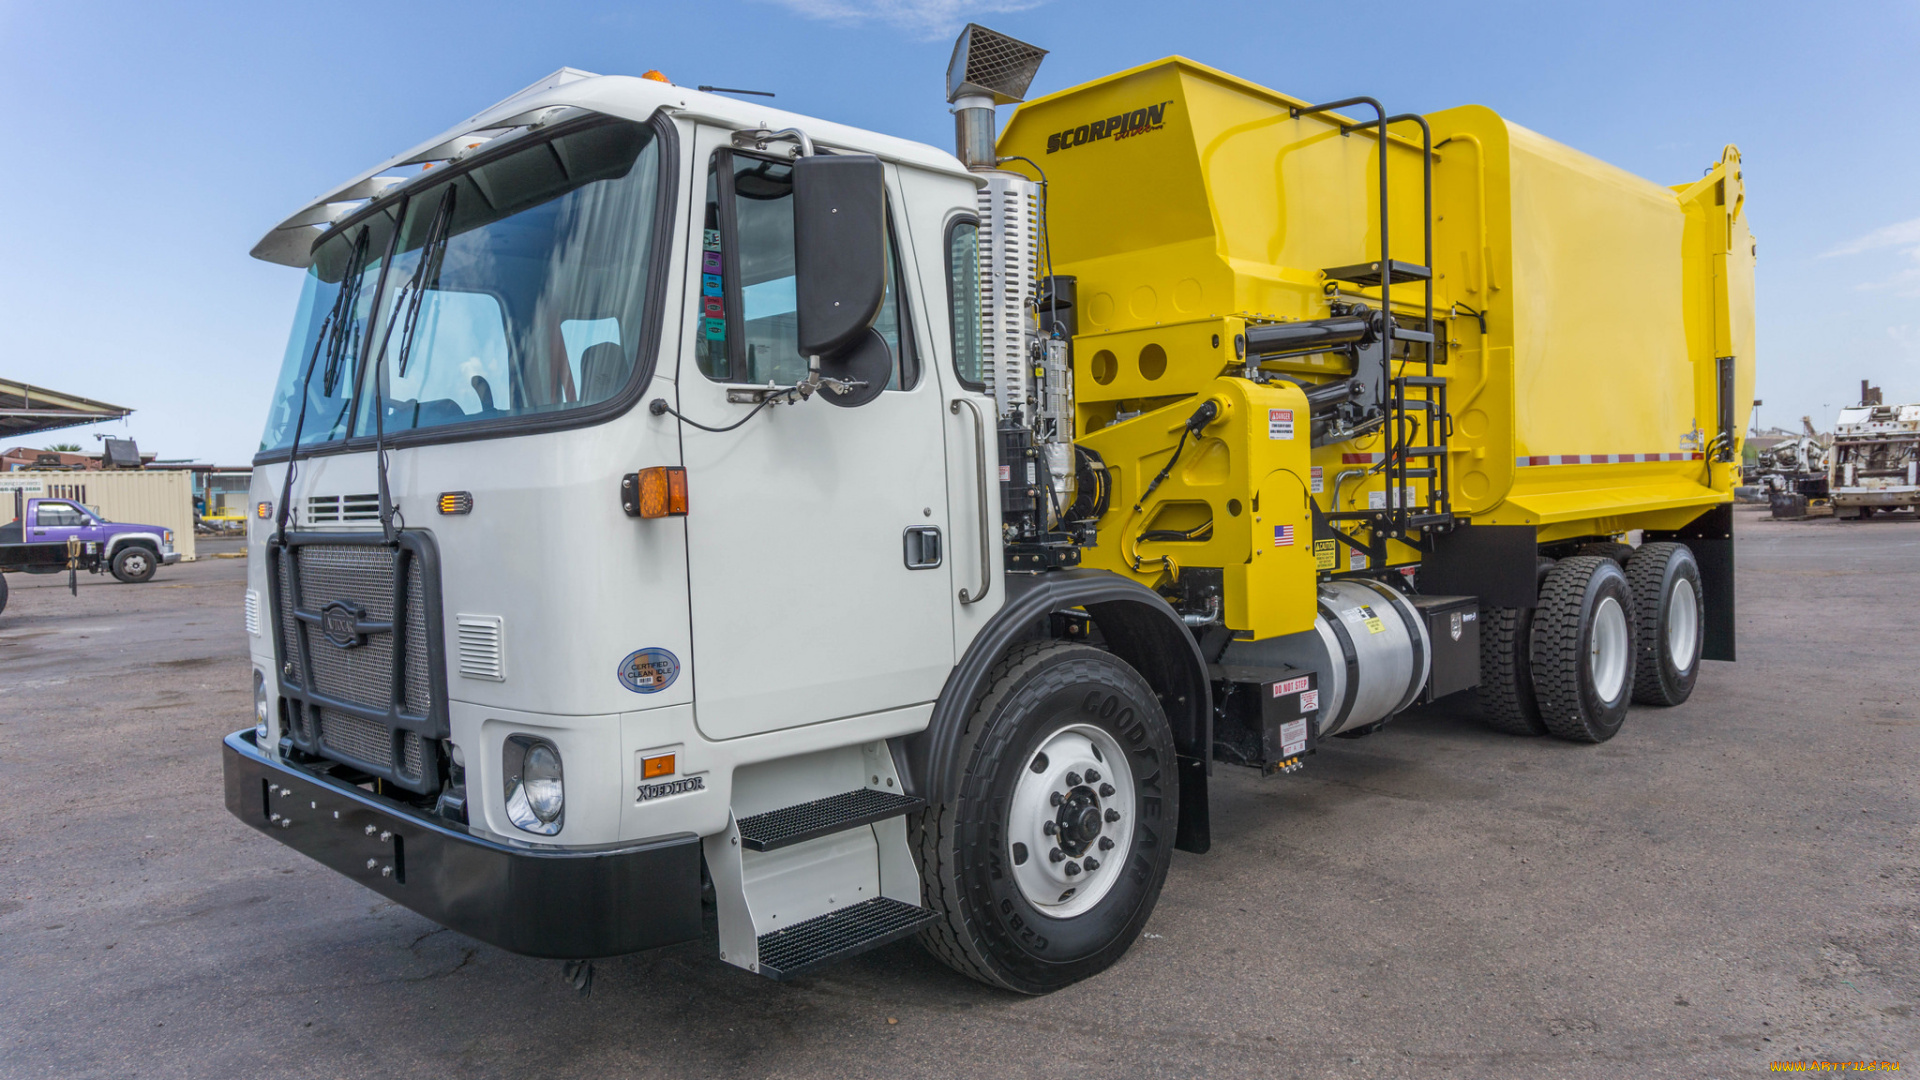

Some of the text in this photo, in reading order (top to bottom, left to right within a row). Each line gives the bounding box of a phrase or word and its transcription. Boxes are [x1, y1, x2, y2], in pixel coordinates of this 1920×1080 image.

[1046, 101, 1167, 155] SCORPION
[627, 667, 672, 679] CLEAN IDLE
[631, 660, 668, 670] CERTIFIED
[1275, 679, 1307, 695] DO NOT STEP
[637, 777, 705, 802] XPEDITOR
[1082, 690, 1162, 885] GOODYEAR
[1001, 899, 1048, 951] G289
